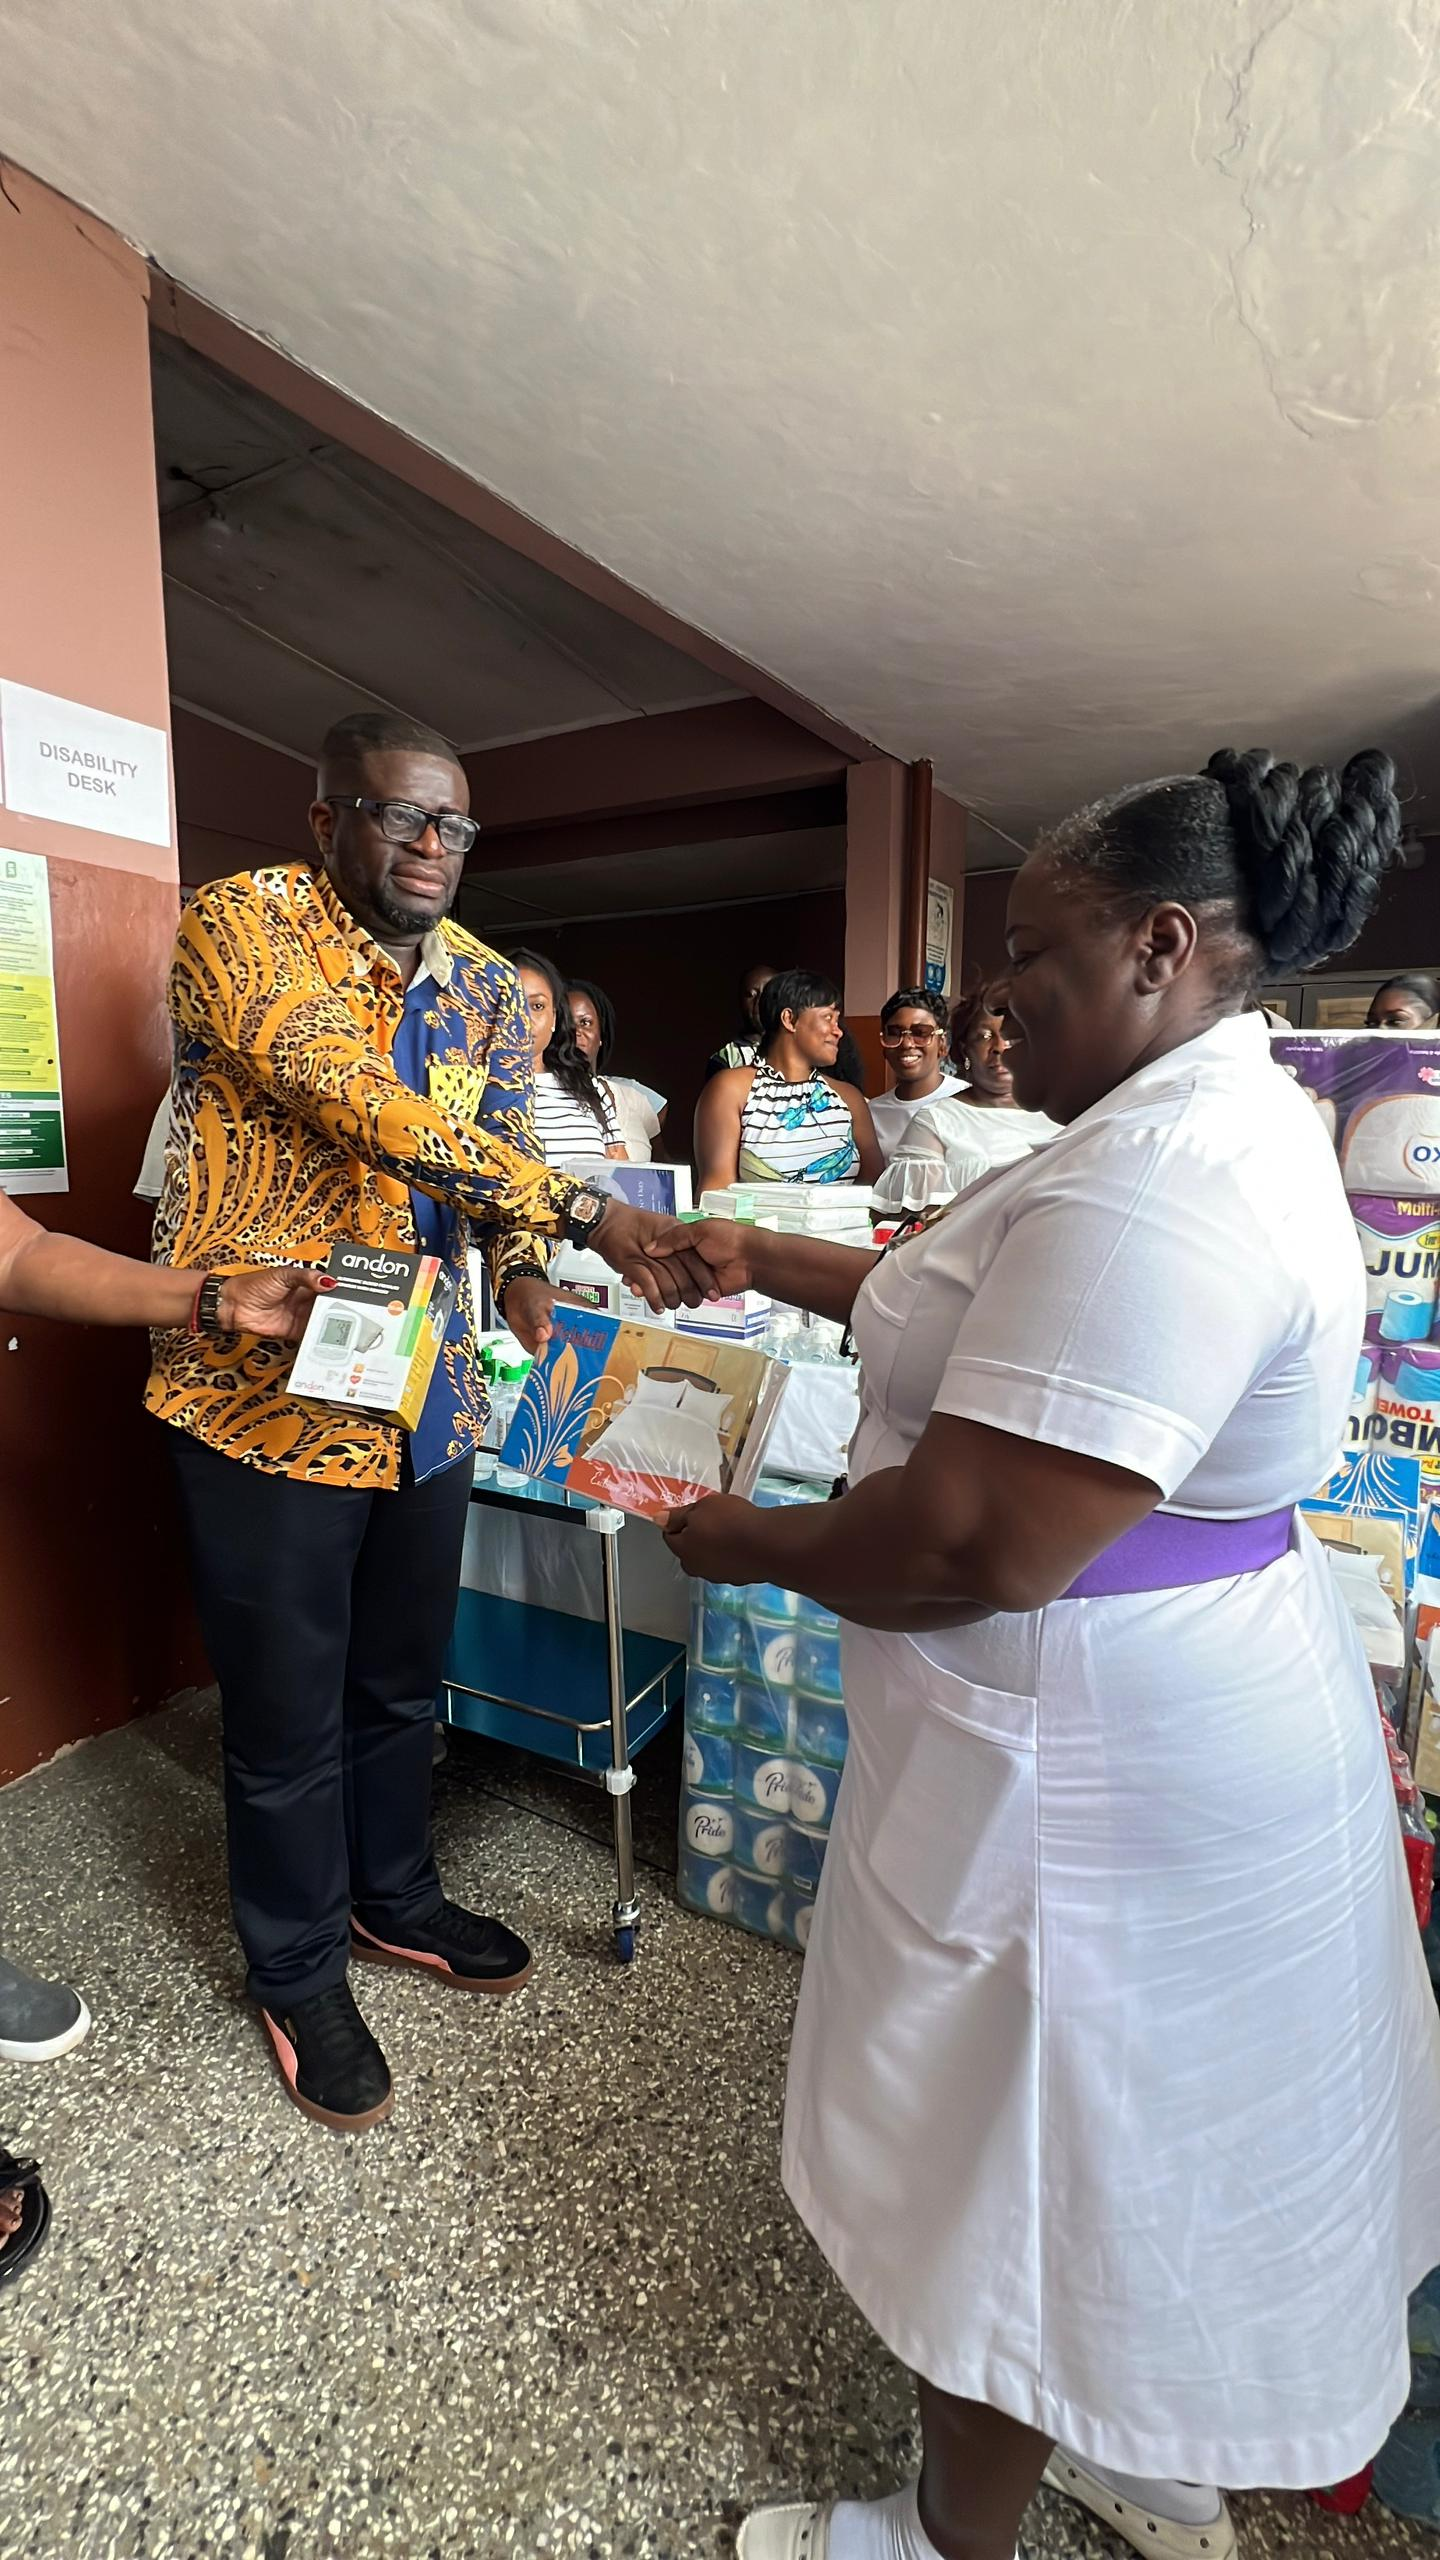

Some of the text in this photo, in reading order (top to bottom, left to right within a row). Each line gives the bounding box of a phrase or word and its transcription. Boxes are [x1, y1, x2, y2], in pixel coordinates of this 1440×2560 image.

[39, 741, 138, 778] DISABILITY
[67, 772, 117, 796] DESK
[341, 1253, 410, 1278] andon
[295, 1381, 325, 1392] andon
[1377, 1399, 1434, 1423] TOWE
[694, 1815, 726, 1838] Pride
